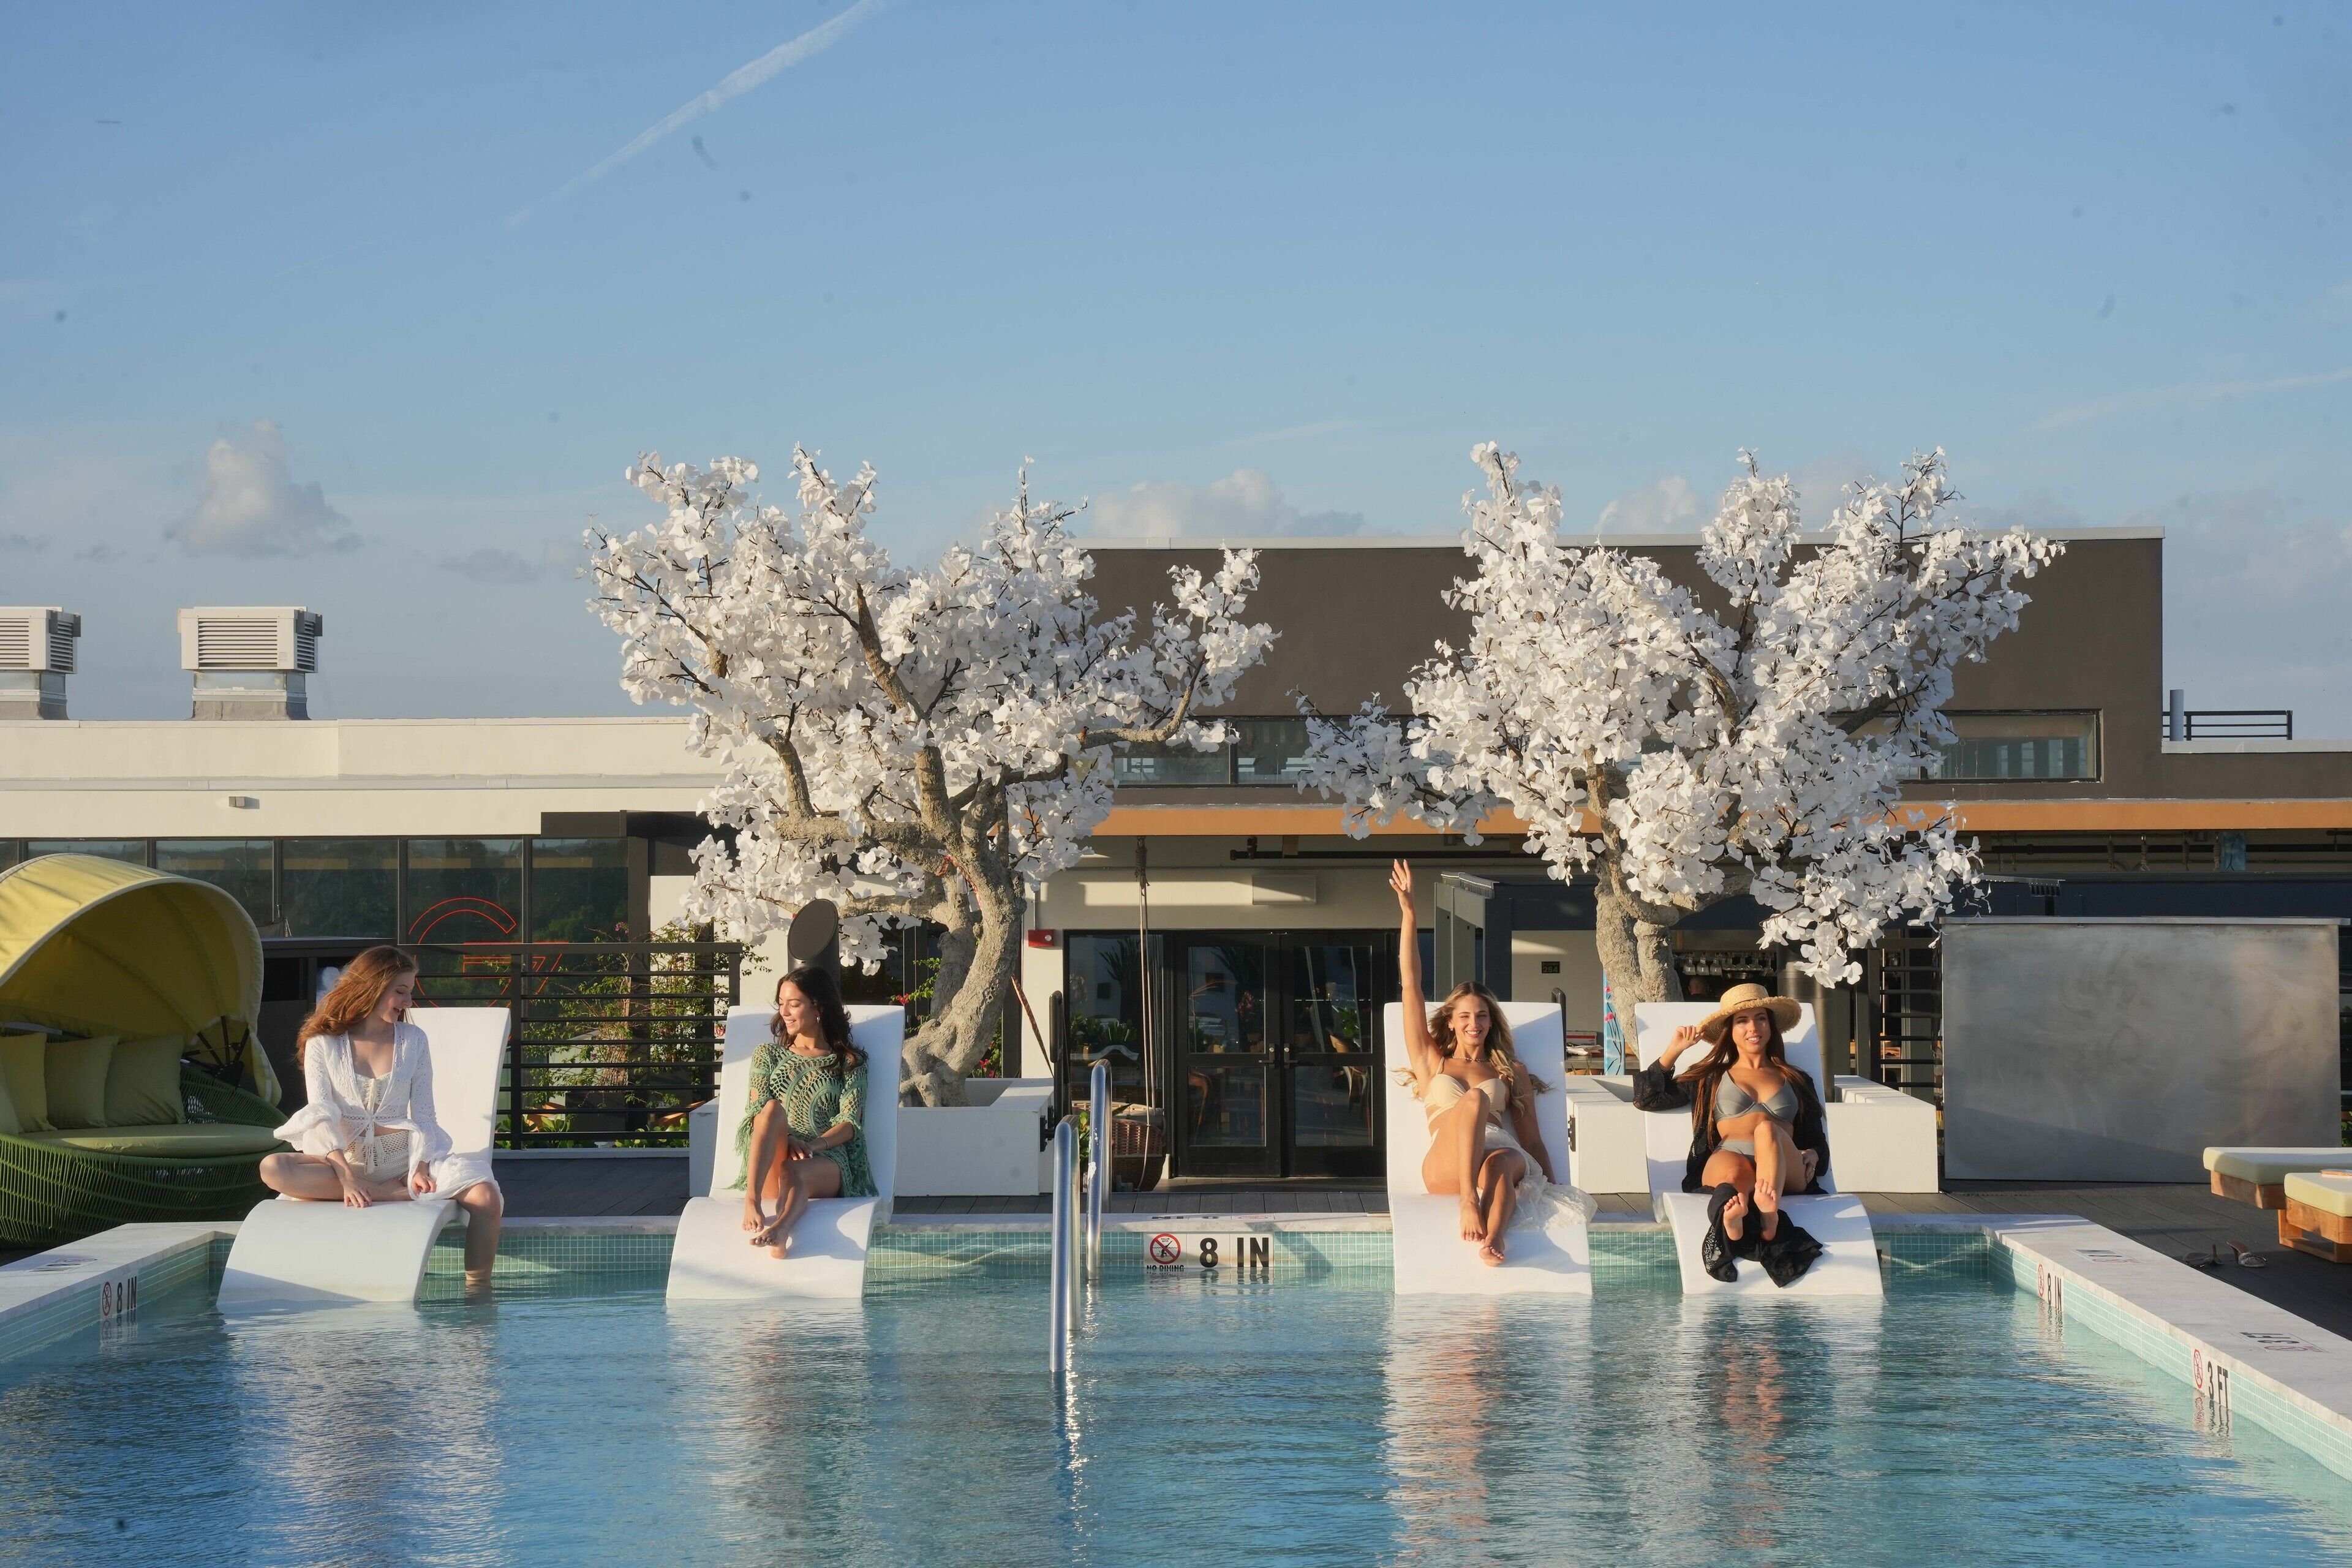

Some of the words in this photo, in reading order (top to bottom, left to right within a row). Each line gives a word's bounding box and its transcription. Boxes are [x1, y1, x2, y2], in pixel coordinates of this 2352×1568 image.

[1199, 1237, 1219, 1268] 8
[1237, 1237, 1269, 1268] IN
[116, 1281, 123, 1314] 8
[127, 1276, 137, 1310] IN
[2047, 1272, 2052, 1305] 8
[2054, 1275, 2062, 1310] IN
[2207, 1360, 2215, 1400] 3
[2217, 1365, 2229, 1409] FT
